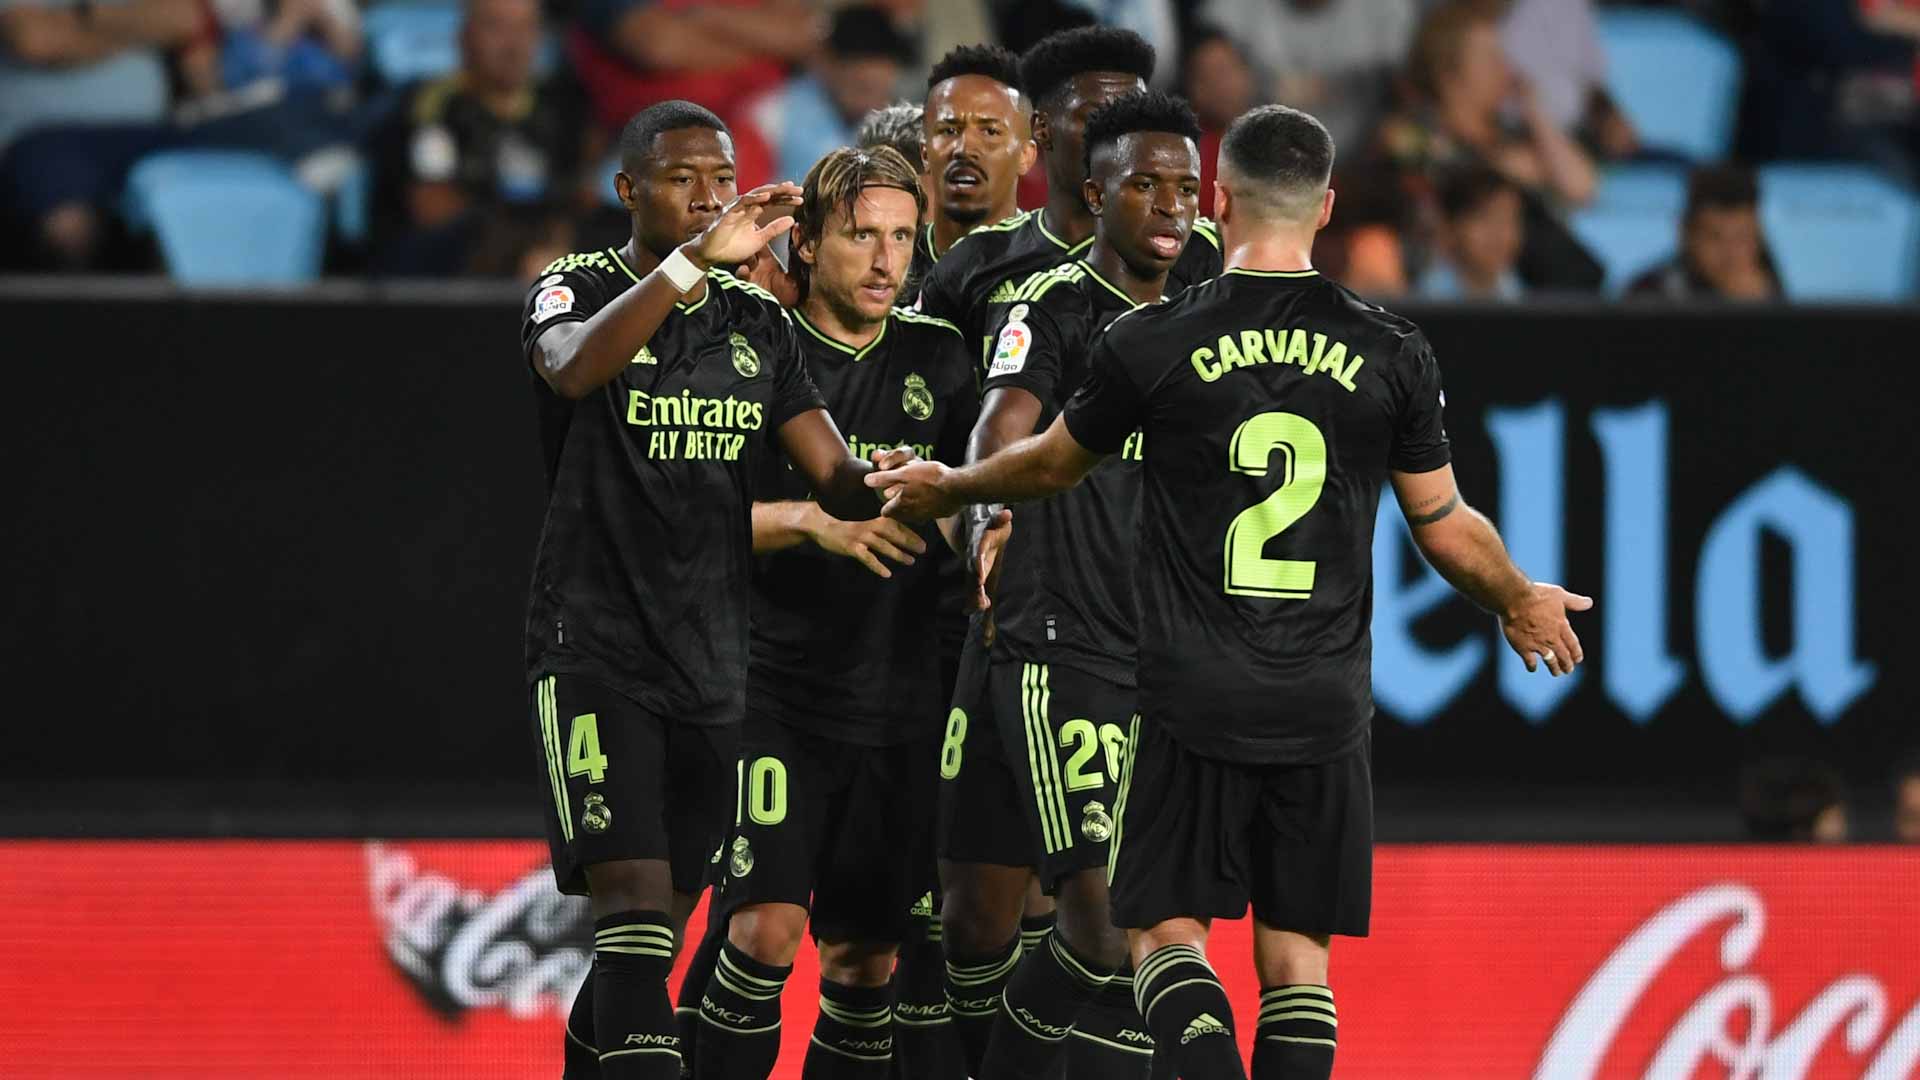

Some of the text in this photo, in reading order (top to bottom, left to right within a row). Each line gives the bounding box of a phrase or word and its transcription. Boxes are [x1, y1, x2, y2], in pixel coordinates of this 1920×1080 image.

[1191, 328, 1365, 393] CARVAJAL
[627, 388, 763, 431] Emirates
[648, 431, 746, 461] FLY BETTER
[1122, 431, 1144, 461] FL
[1224, 412, 1327, 600] 2
[566, 713, 608, 785] 4
[1532, 879, 1920, 1080] Coc
[702, 994, 757, 1024] RMCF
[625, 1033, 681, 1046] RMCF
